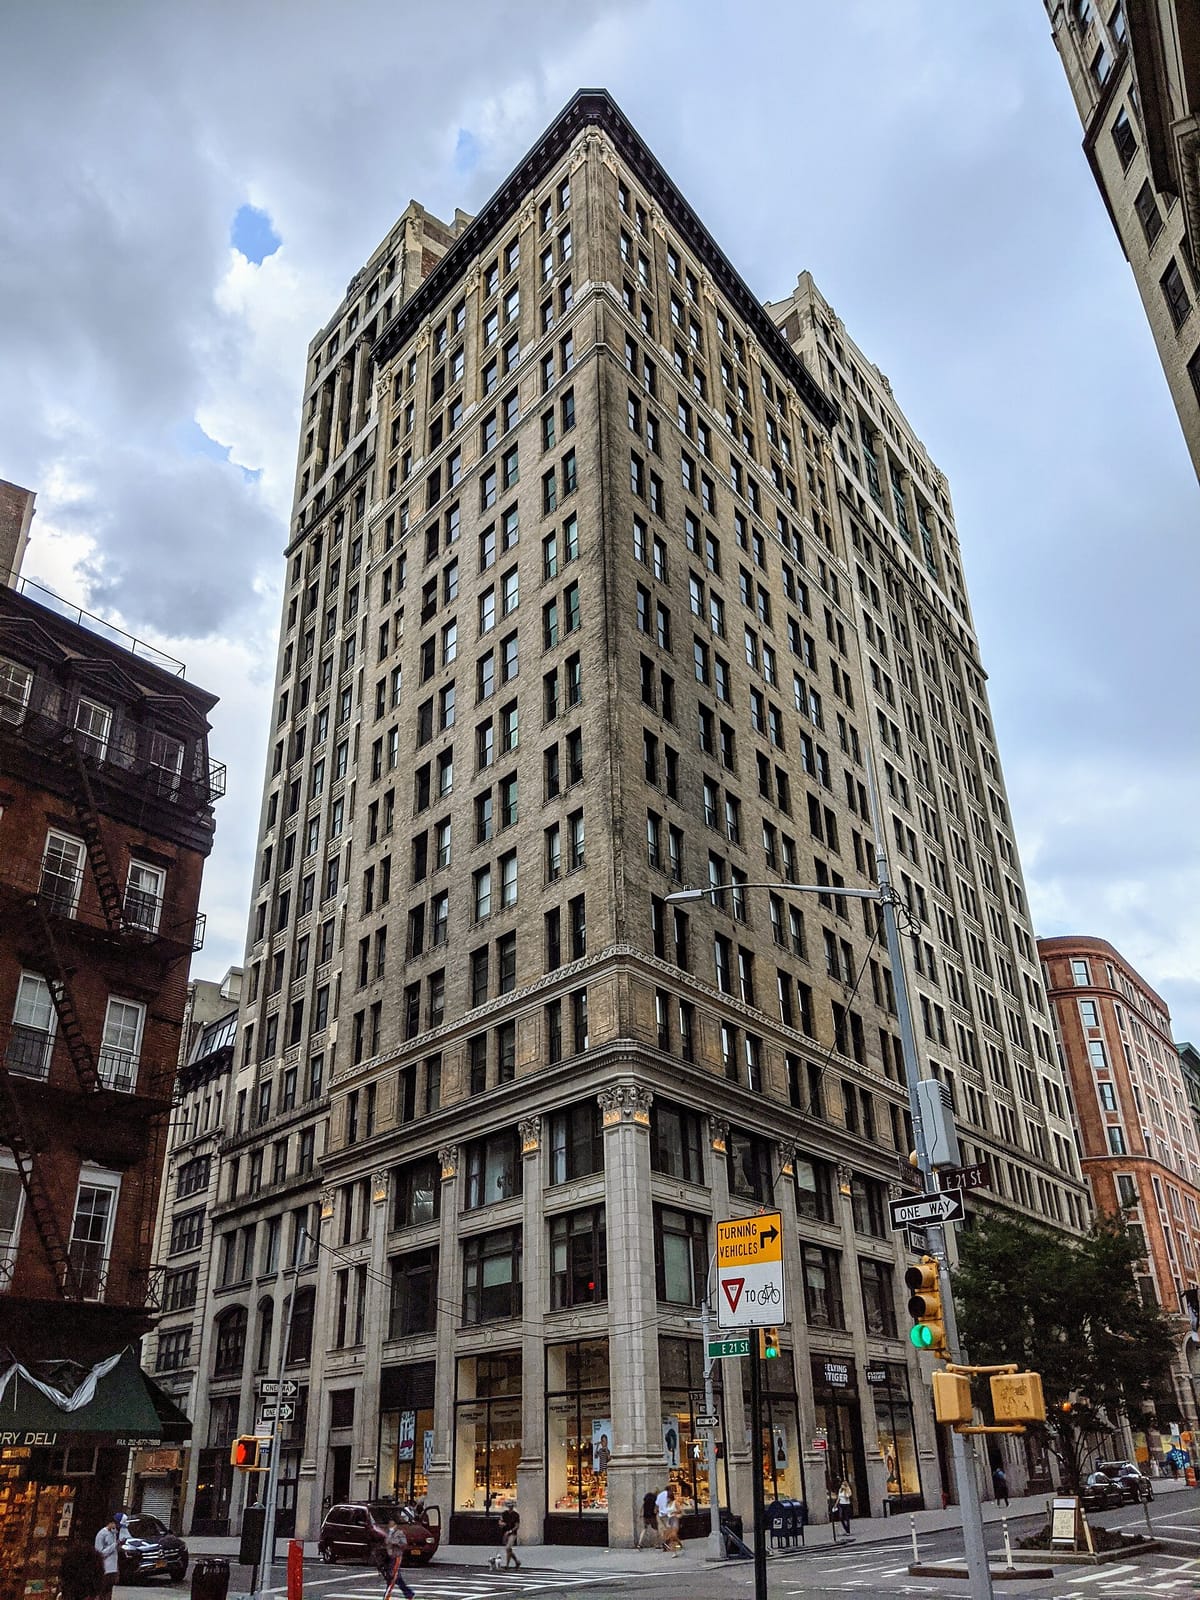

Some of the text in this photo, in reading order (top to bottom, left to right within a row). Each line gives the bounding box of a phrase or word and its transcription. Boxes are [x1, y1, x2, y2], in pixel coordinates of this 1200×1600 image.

[945, 1169, 982, 1190] E 21 St
[900, 1200, 951, 1219] ONE WAY
[719, 1223, 757, 1240] TURNING
[719, 1242, 758, 1258] VEHICLES
[745, 1289, 756, 1303] TO
[721, 1342, 749, 1354] E 21 St
[825, 1363, 848, 1373] FLYING
[826, 1372, 848, 1383] TIGER
[0, 1432, 57, 1445] RY DELI
